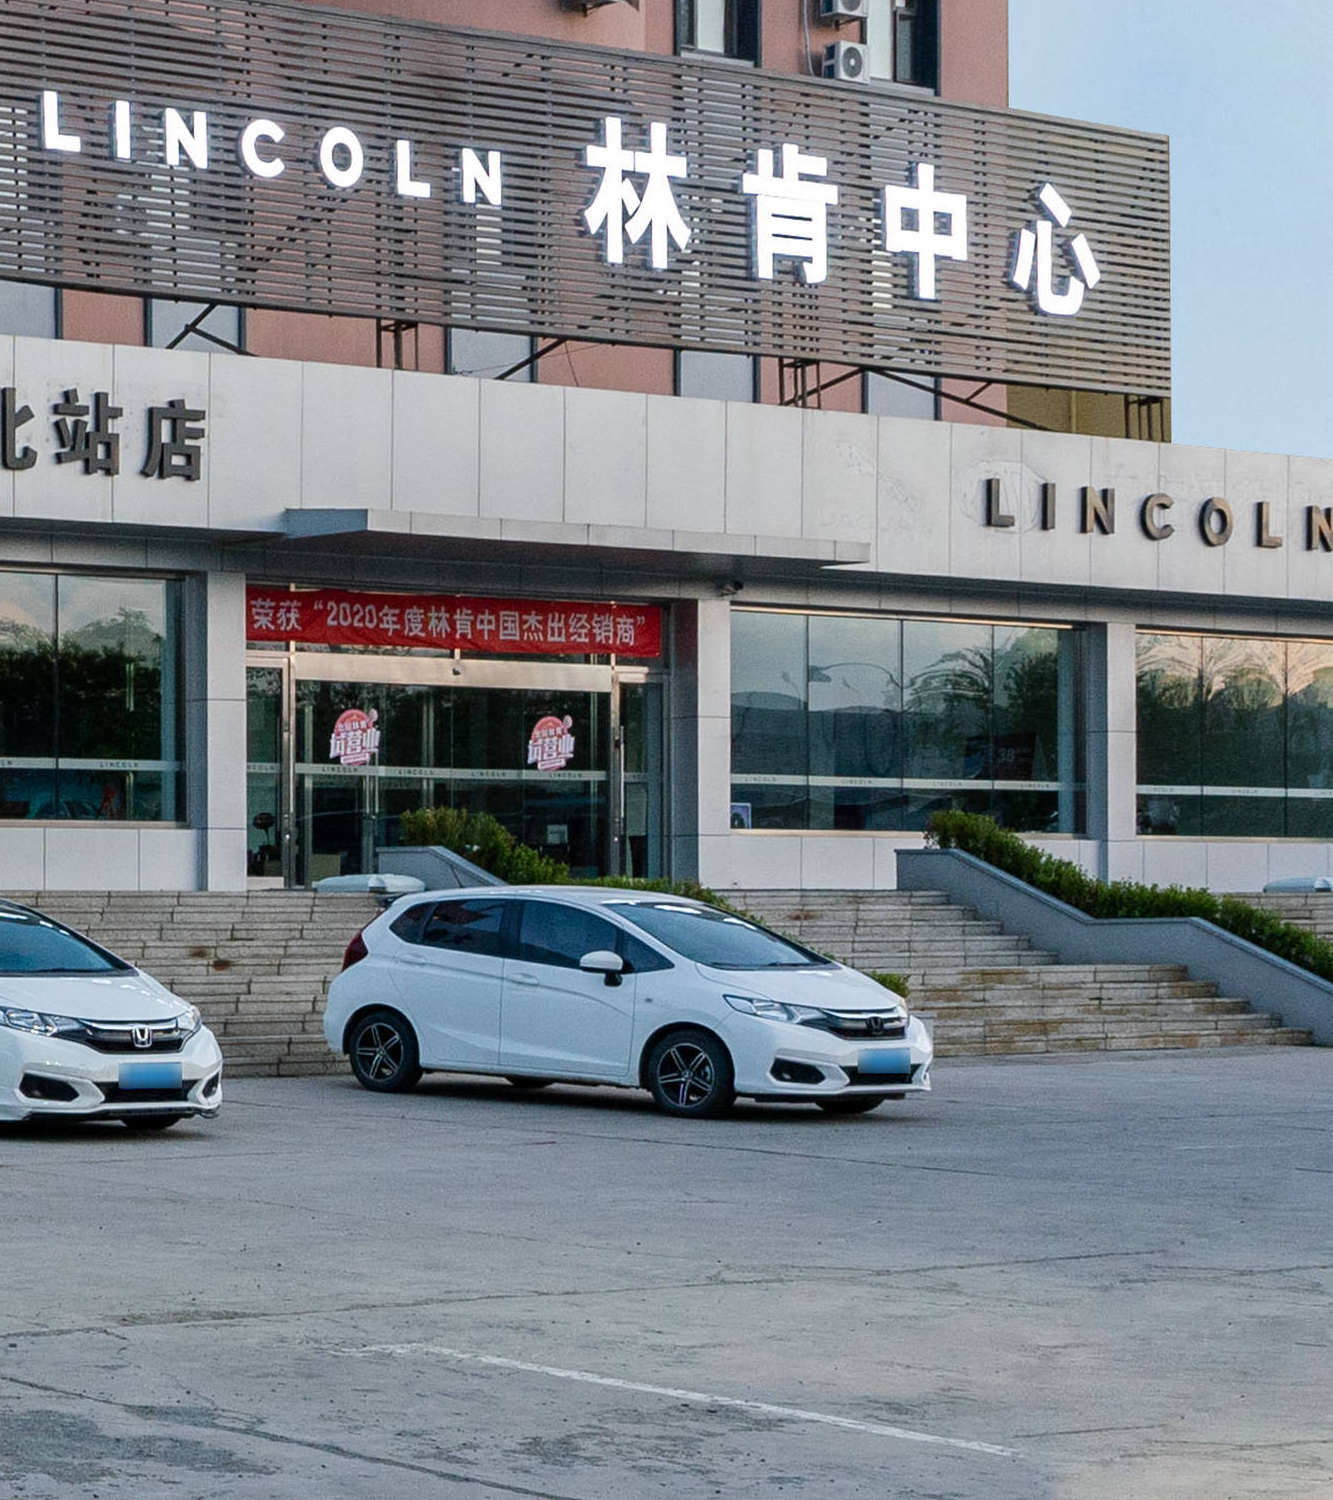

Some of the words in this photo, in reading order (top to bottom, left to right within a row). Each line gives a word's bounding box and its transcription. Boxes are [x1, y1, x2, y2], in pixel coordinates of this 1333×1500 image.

[42, 89, 503, 207] LINCOLN
[583, 115, 1102, 317] 林肯中心
[984, 477, 1333, 553] LINCOLN
